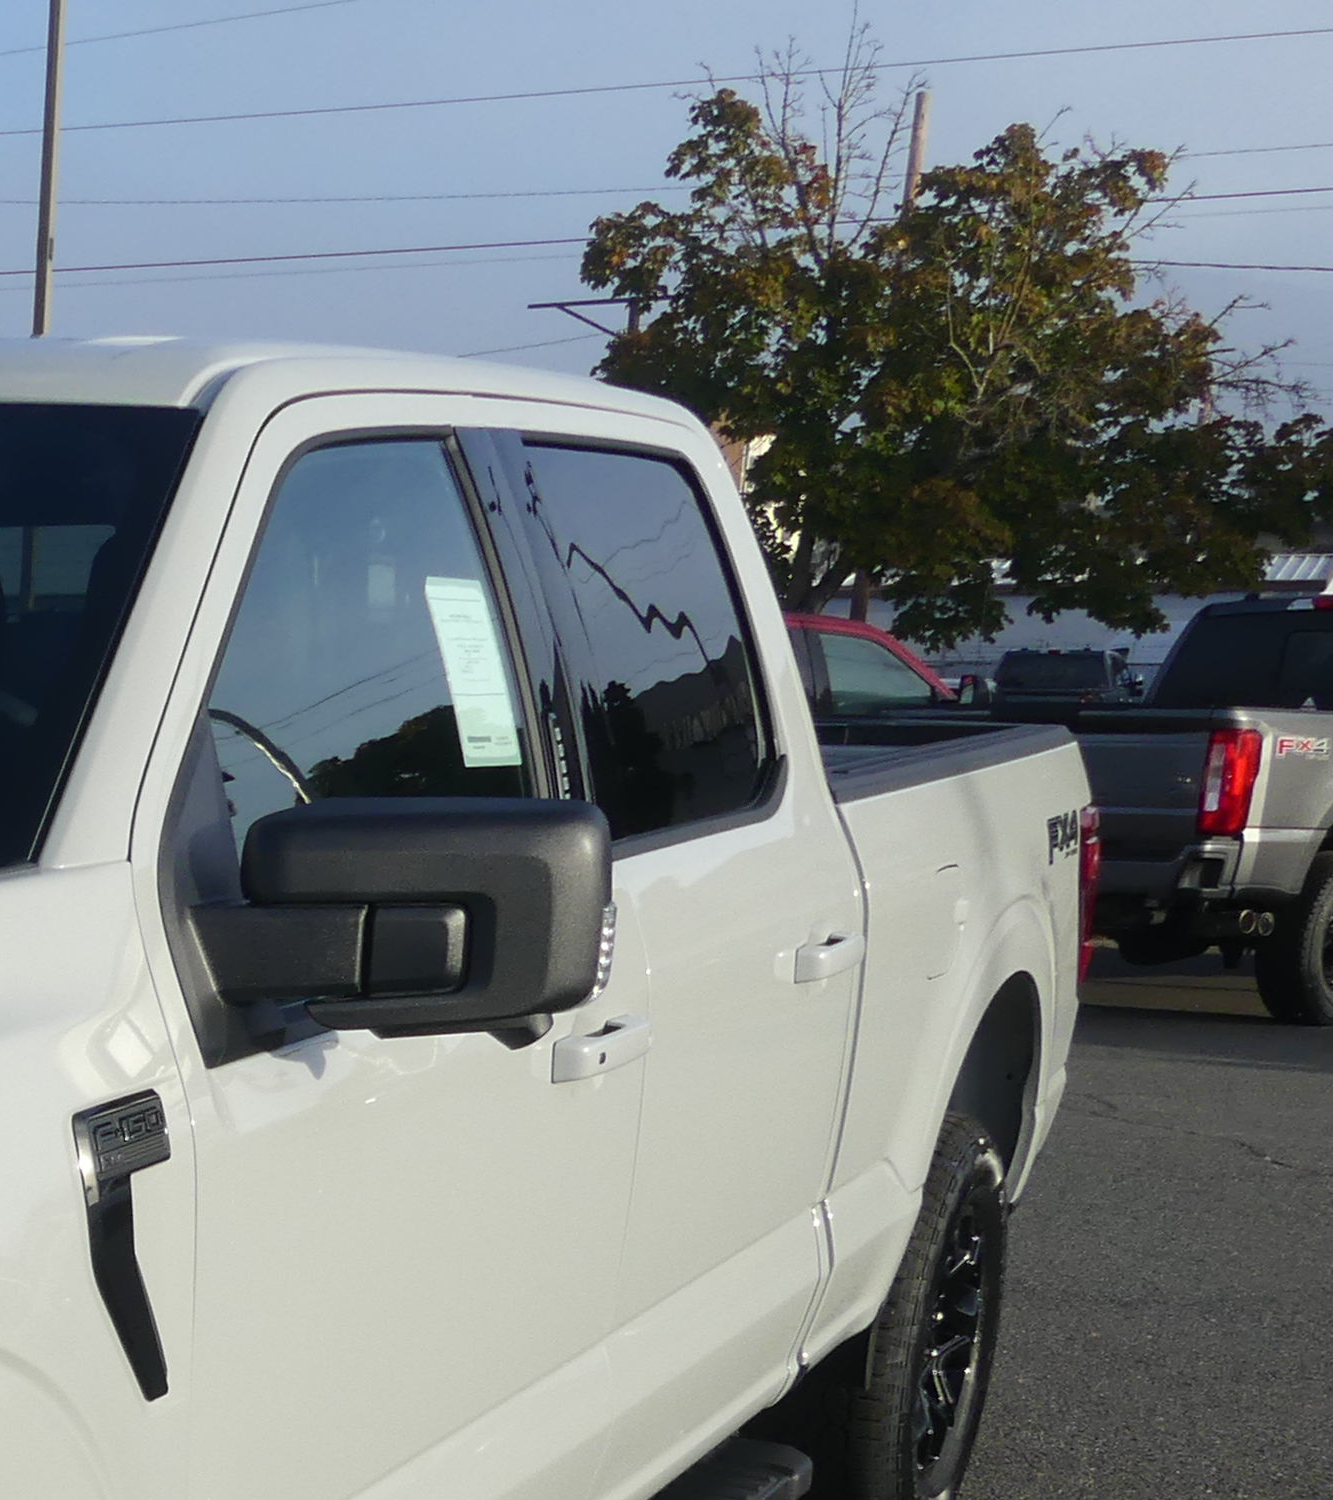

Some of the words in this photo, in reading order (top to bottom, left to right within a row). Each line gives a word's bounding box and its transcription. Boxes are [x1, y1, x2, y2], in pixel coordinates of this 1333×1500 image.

[1277, 737, 1330, 758] FX4
[1047, 810, 1078, 865] FX4
[93, 1106, 164, 1152] F-150
